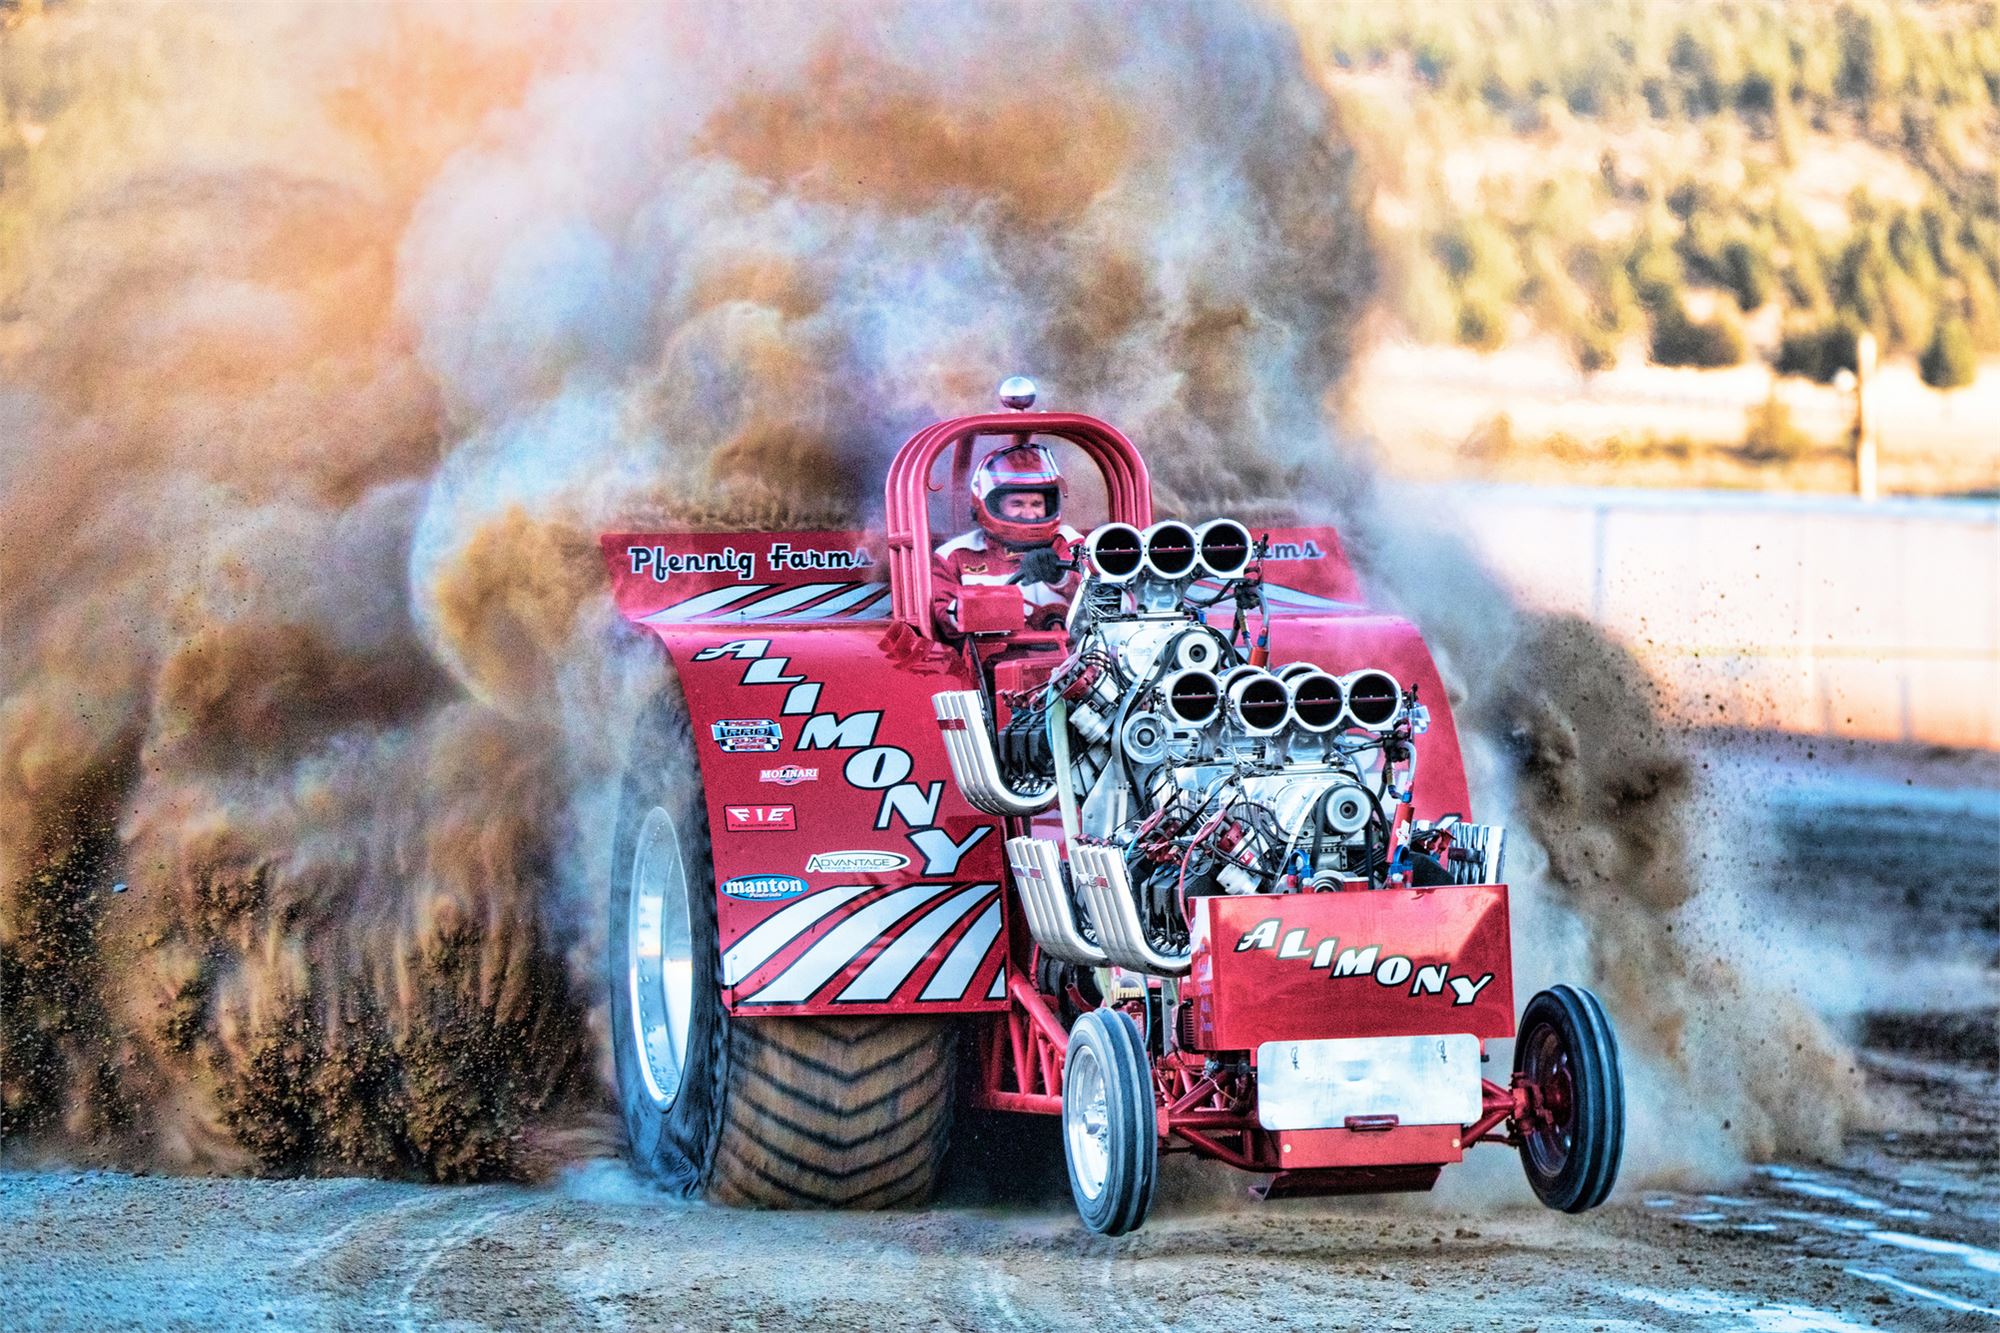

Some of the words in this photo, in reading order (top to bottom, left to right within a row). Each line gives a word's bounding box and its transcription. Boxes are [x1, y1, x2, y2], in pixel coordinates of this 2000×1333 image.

[628, 545, 755, 583] Pfennig
[768, 543, 873, 571] Farms
[690, 638, 996, 878] ALIMONY
[761, 768, 818, 780] MOLINARI
[728, 807, 792, 822] FIE
[808, 853, 891, 871] ADVANTAGE
[726, 878, 803, 894] manton
[1233, 917, 1496, 1007] ALIMONY
